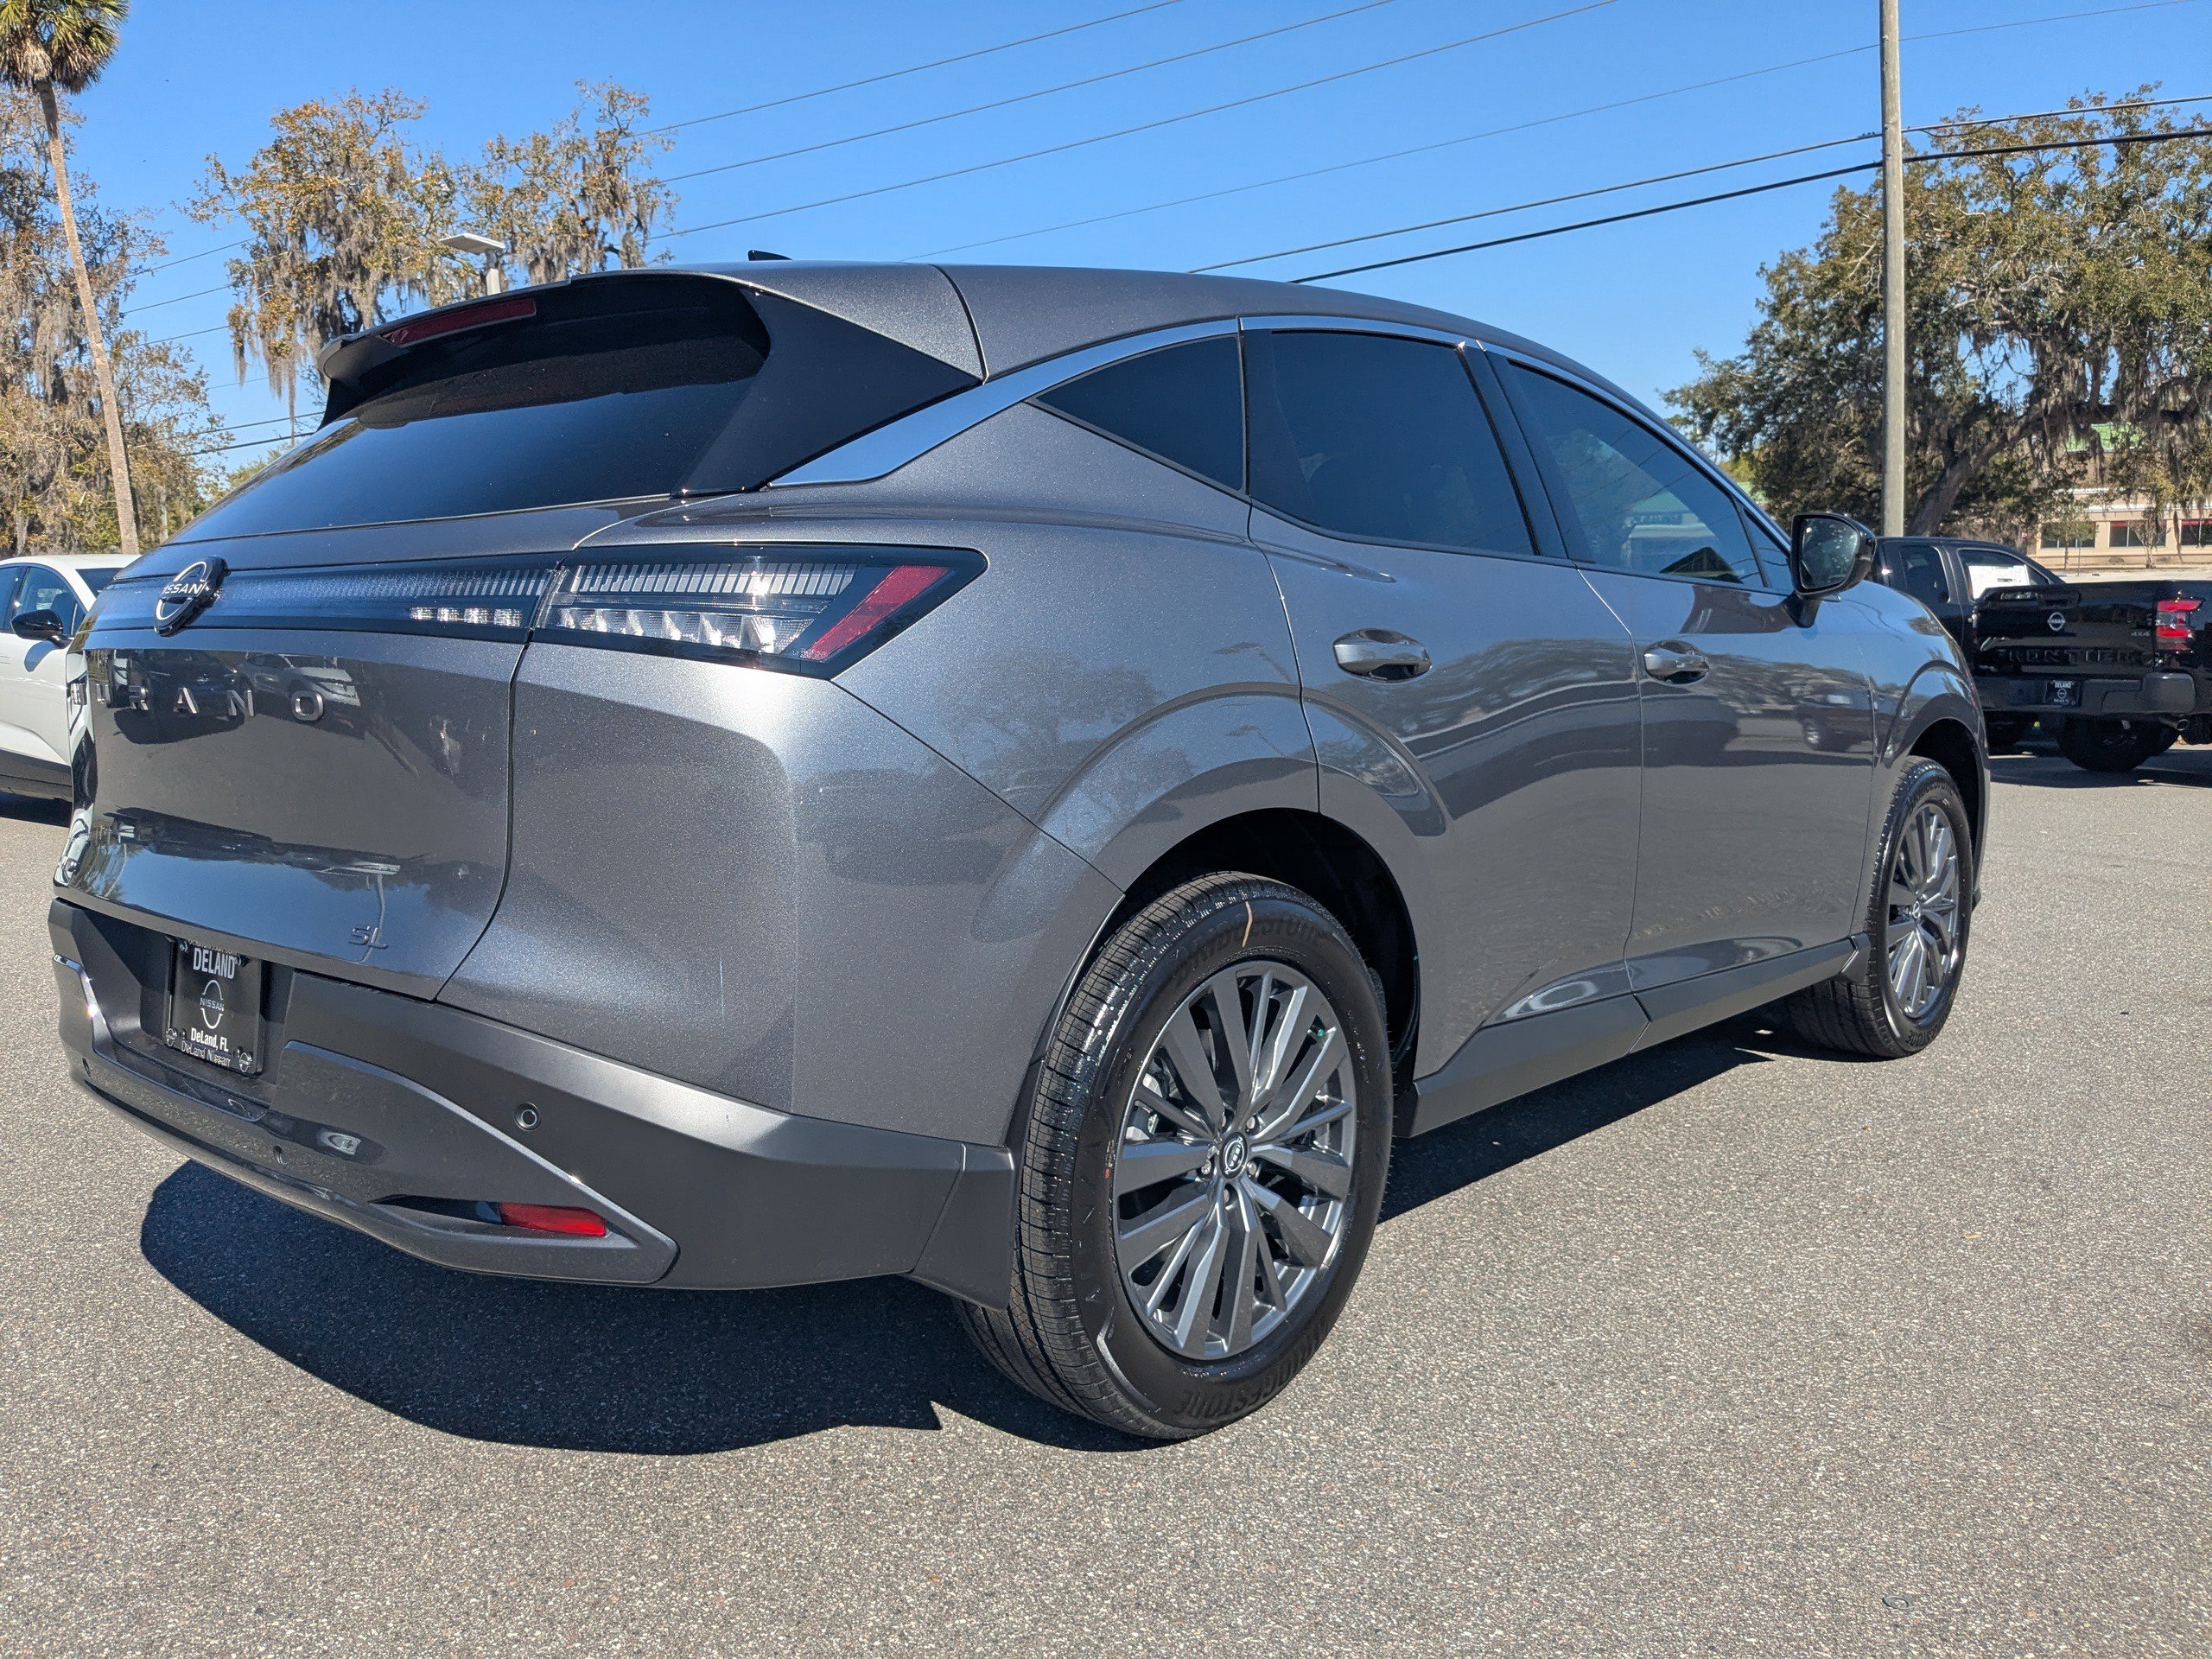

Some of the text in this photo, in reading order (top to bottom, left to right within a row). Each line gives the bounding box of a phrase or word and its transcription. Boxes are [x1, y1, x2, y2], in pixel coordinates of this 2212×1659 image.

[348, 925, 389, 950] SL
[193, 947, 236, 979] DELAND
[200, 997, 225, 1012] NISSAN
[191, 1027, 229, 1052] DeLand, FL
[181, 1040, 206, 1059] DeLand
[207, 1049, 231, 1068] Nissan
